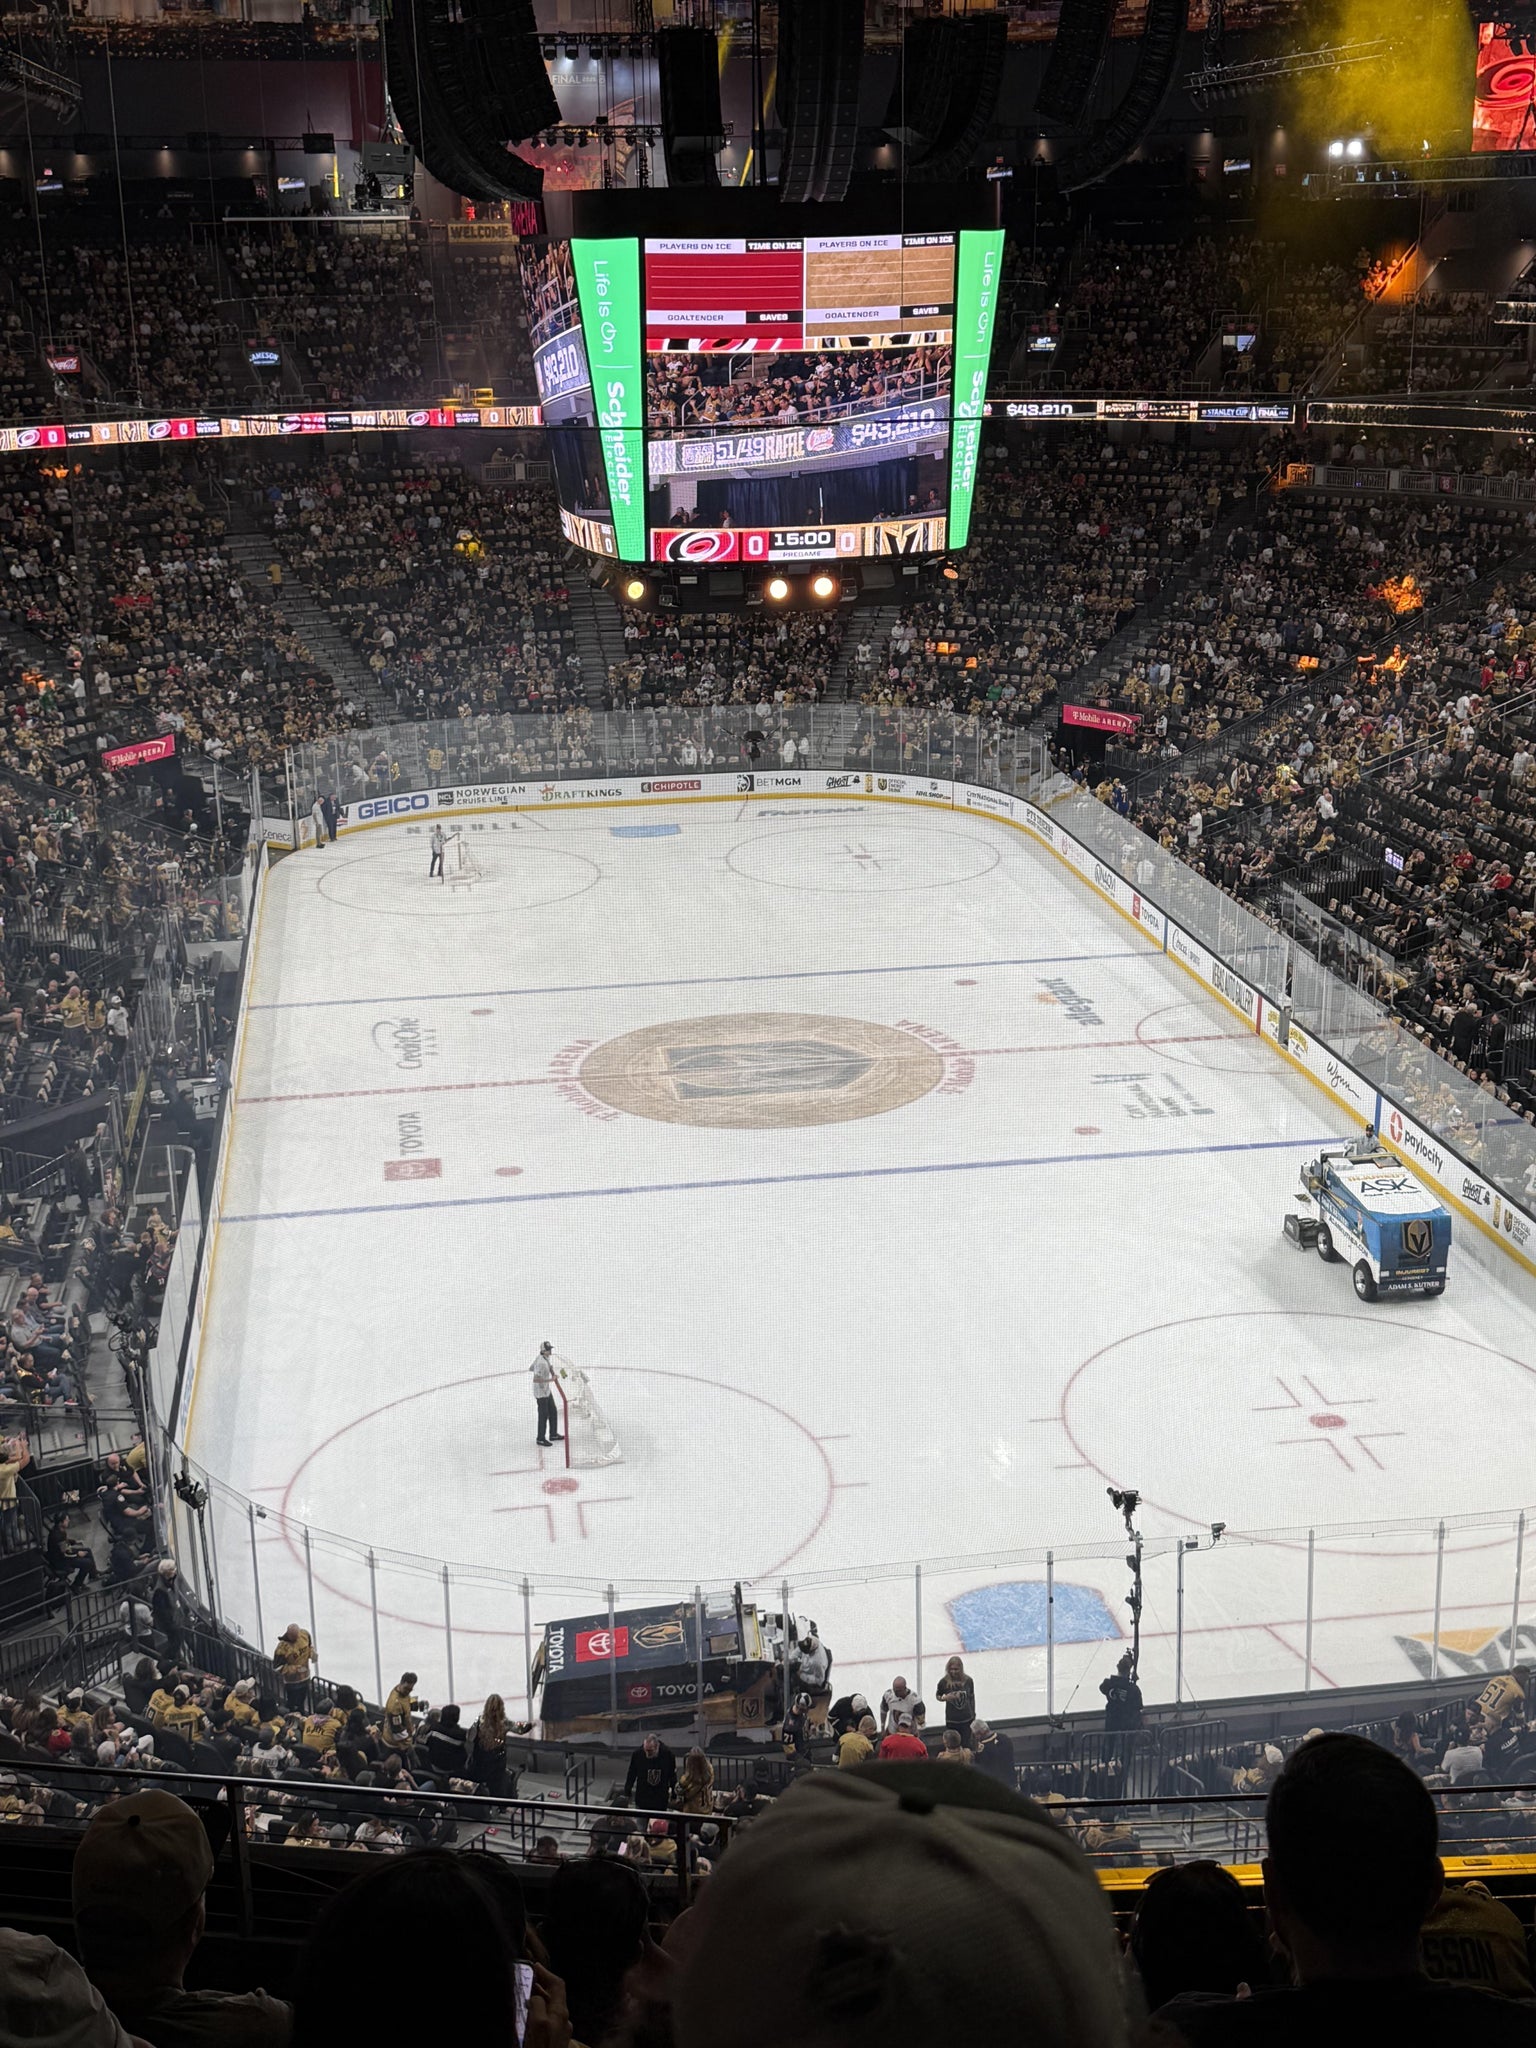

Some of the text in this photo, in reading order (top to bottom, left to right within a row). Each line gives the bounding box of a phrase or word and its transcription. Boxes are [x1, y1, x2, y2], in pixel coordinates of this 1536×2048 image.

[552, 74, 582, 84] FINAL
[450, 225, 508, 240] WELCOME
[748, 241, 802, 250] TIME ON ICE
[819, 240, 858, 249] PLAYERS
[874, 239, 889, 247] ICE
[904, 235, 953, 246] TIME ON ICE
[982, 251, 995, 287] Life
[593, 260, 608, 297] Life
[979, 289, 992, 308] Is
[598, 301, 613, 318] Is
[825, 310, 879, 319] GOALTENDER
[912, 306, 940, 315] SAVES
[759, 313, 788, 321] SAVES
[489, 412, 498, 424] 0
[1207, 407, 1249, 417] STANLEY CUP
[1258, 408, 1279, 417] FINAL
[101, 427, 111, 439] 0
[178, 423, 188, 434] 0
[851, 408, 936, 447] $43,210
[961, 369, 985, 493] Schneider
[48, 432, 58, 443] 0
[68, 430, 91, 440] HITS
[606, 380, 632, 507] Schneider
[715, 436, 765, 462] 51/49
[765, 432, 806, 461] RAFFLE
[774, 530, 831, 547] 15:00
[840, 532, 855, 553] 0
[748, 535, 763, 556] 0
[782, 550, 821, 558] PREGAME
[1102, 717, 1127, 729] ARENA
[138, 746, 162, 759] ARENA
[653, 780, 701, 791] CHIPOTLE
[756, 777, 802, 787] BETMGM
[438, 792, 454, 802] NCL
[456, 786, 527, 798] NORWEGIAN
[542, 787, 623, 802] DRAFTKINGS
[456, 794, 508, 805] CRUISE LINE
[358, 793, 430, 820] GEICO
[1142, 906, 1159, 930] TOYOTA
[1033, 977, 1105, 1026] allegiant
[398, 1111, 424, 1156] TOYOTA
[1404, 1129, 1444, 1174] paylocity
[1361, 1178, 1418, 1194] ASK
[1387, 1280, 1440, 1291] ADAM S. KUTNER
[549, 1626, 565, 1675] TOYOTA
[783, 1732, 794, 1745] 71
